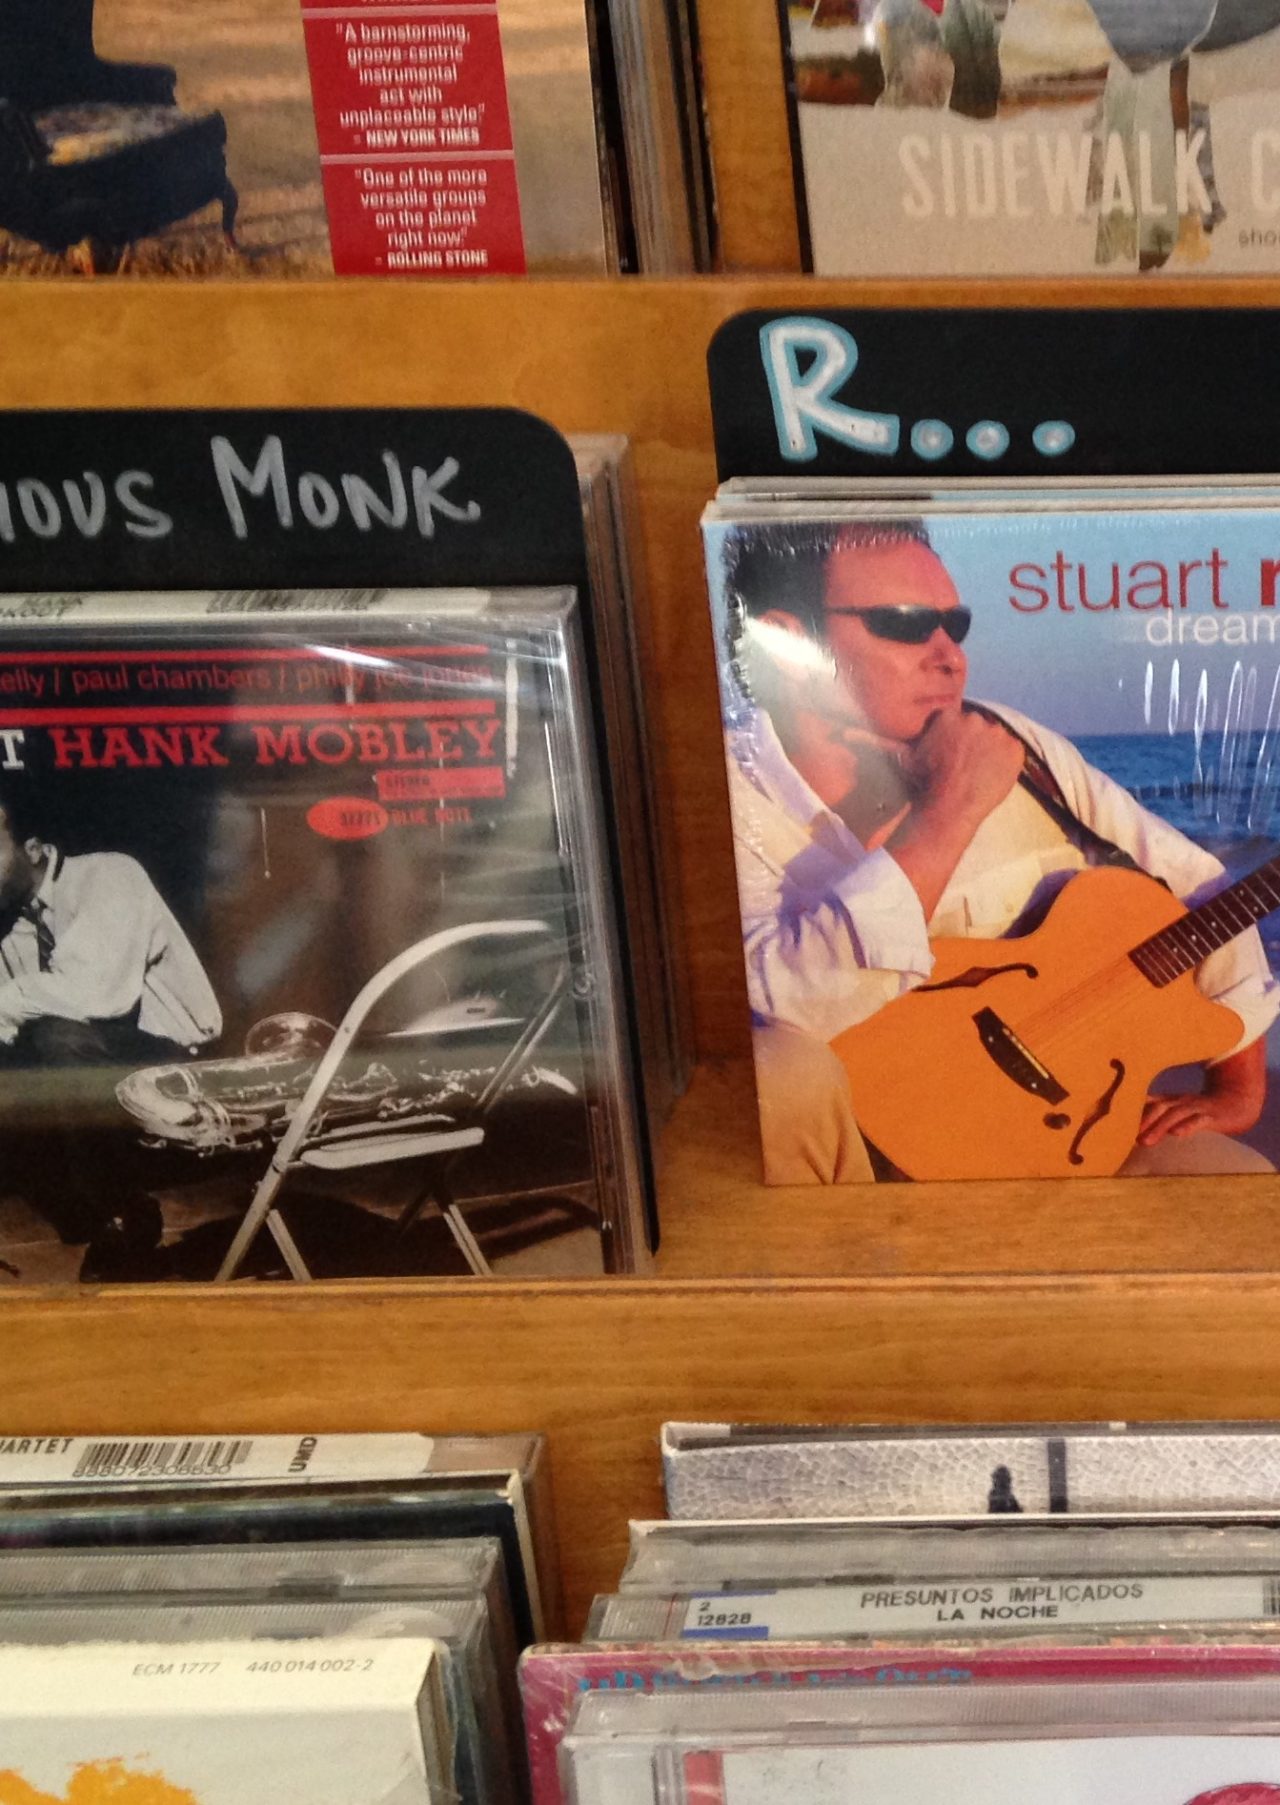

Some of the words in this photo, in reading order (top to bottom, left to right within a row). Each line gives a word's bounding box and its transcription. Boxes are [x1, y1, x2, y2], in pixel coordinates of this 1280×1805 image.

[358, 63, 458, 86] instrumental
[379, 87, 405, 106] act
[408, 85, 443, 104] with
[339, 105, 437, 130] unplaceable
[366, 129, 398, 148] NEW
[400, 128, 437, 148] YORK
[440, 126, 481, 147] TIMES
[398, 166, 414, 188] of
[417, 166, 444, 188] the
[447, 168, 488, 187] more
[898, 128, 1213, 219] SIDEWALK
[360, 187, 428, 210] versatile
[432, 188, 487, 210] groups
[375, 211, 395, 230] on
[398, 208, 424, 229] the
[428, 207, 478, 231] planet
[387, 228, 424, 250] right
[387, 250, 443, 270] ROLLING
[445, 248, 489, 268] STONE
[1008, 548, 1229, 614] stuart
[71, 663, 130, 697] paul
[136, 663, 272, 691] chambers
[48, 726, 230, 769] HANK
[250, 718, 501, 766] MOBLEY
[859, 1586, 995, 1609] PRESUNTOS
[1008, 1582, 1145, 1603] IMPLICADOS
[699, 1601, 712, 1613] 2
[936, 1608, 965, 1622] LA
[980, 1604, 1059, 1621] NOCHE
[131, 1662, 173, 1678] ECM
[179, 1661, 222, 1676] 1777
[245, 1660, 284, 1674] 440
[284, 1659, 316, 1674] 014
